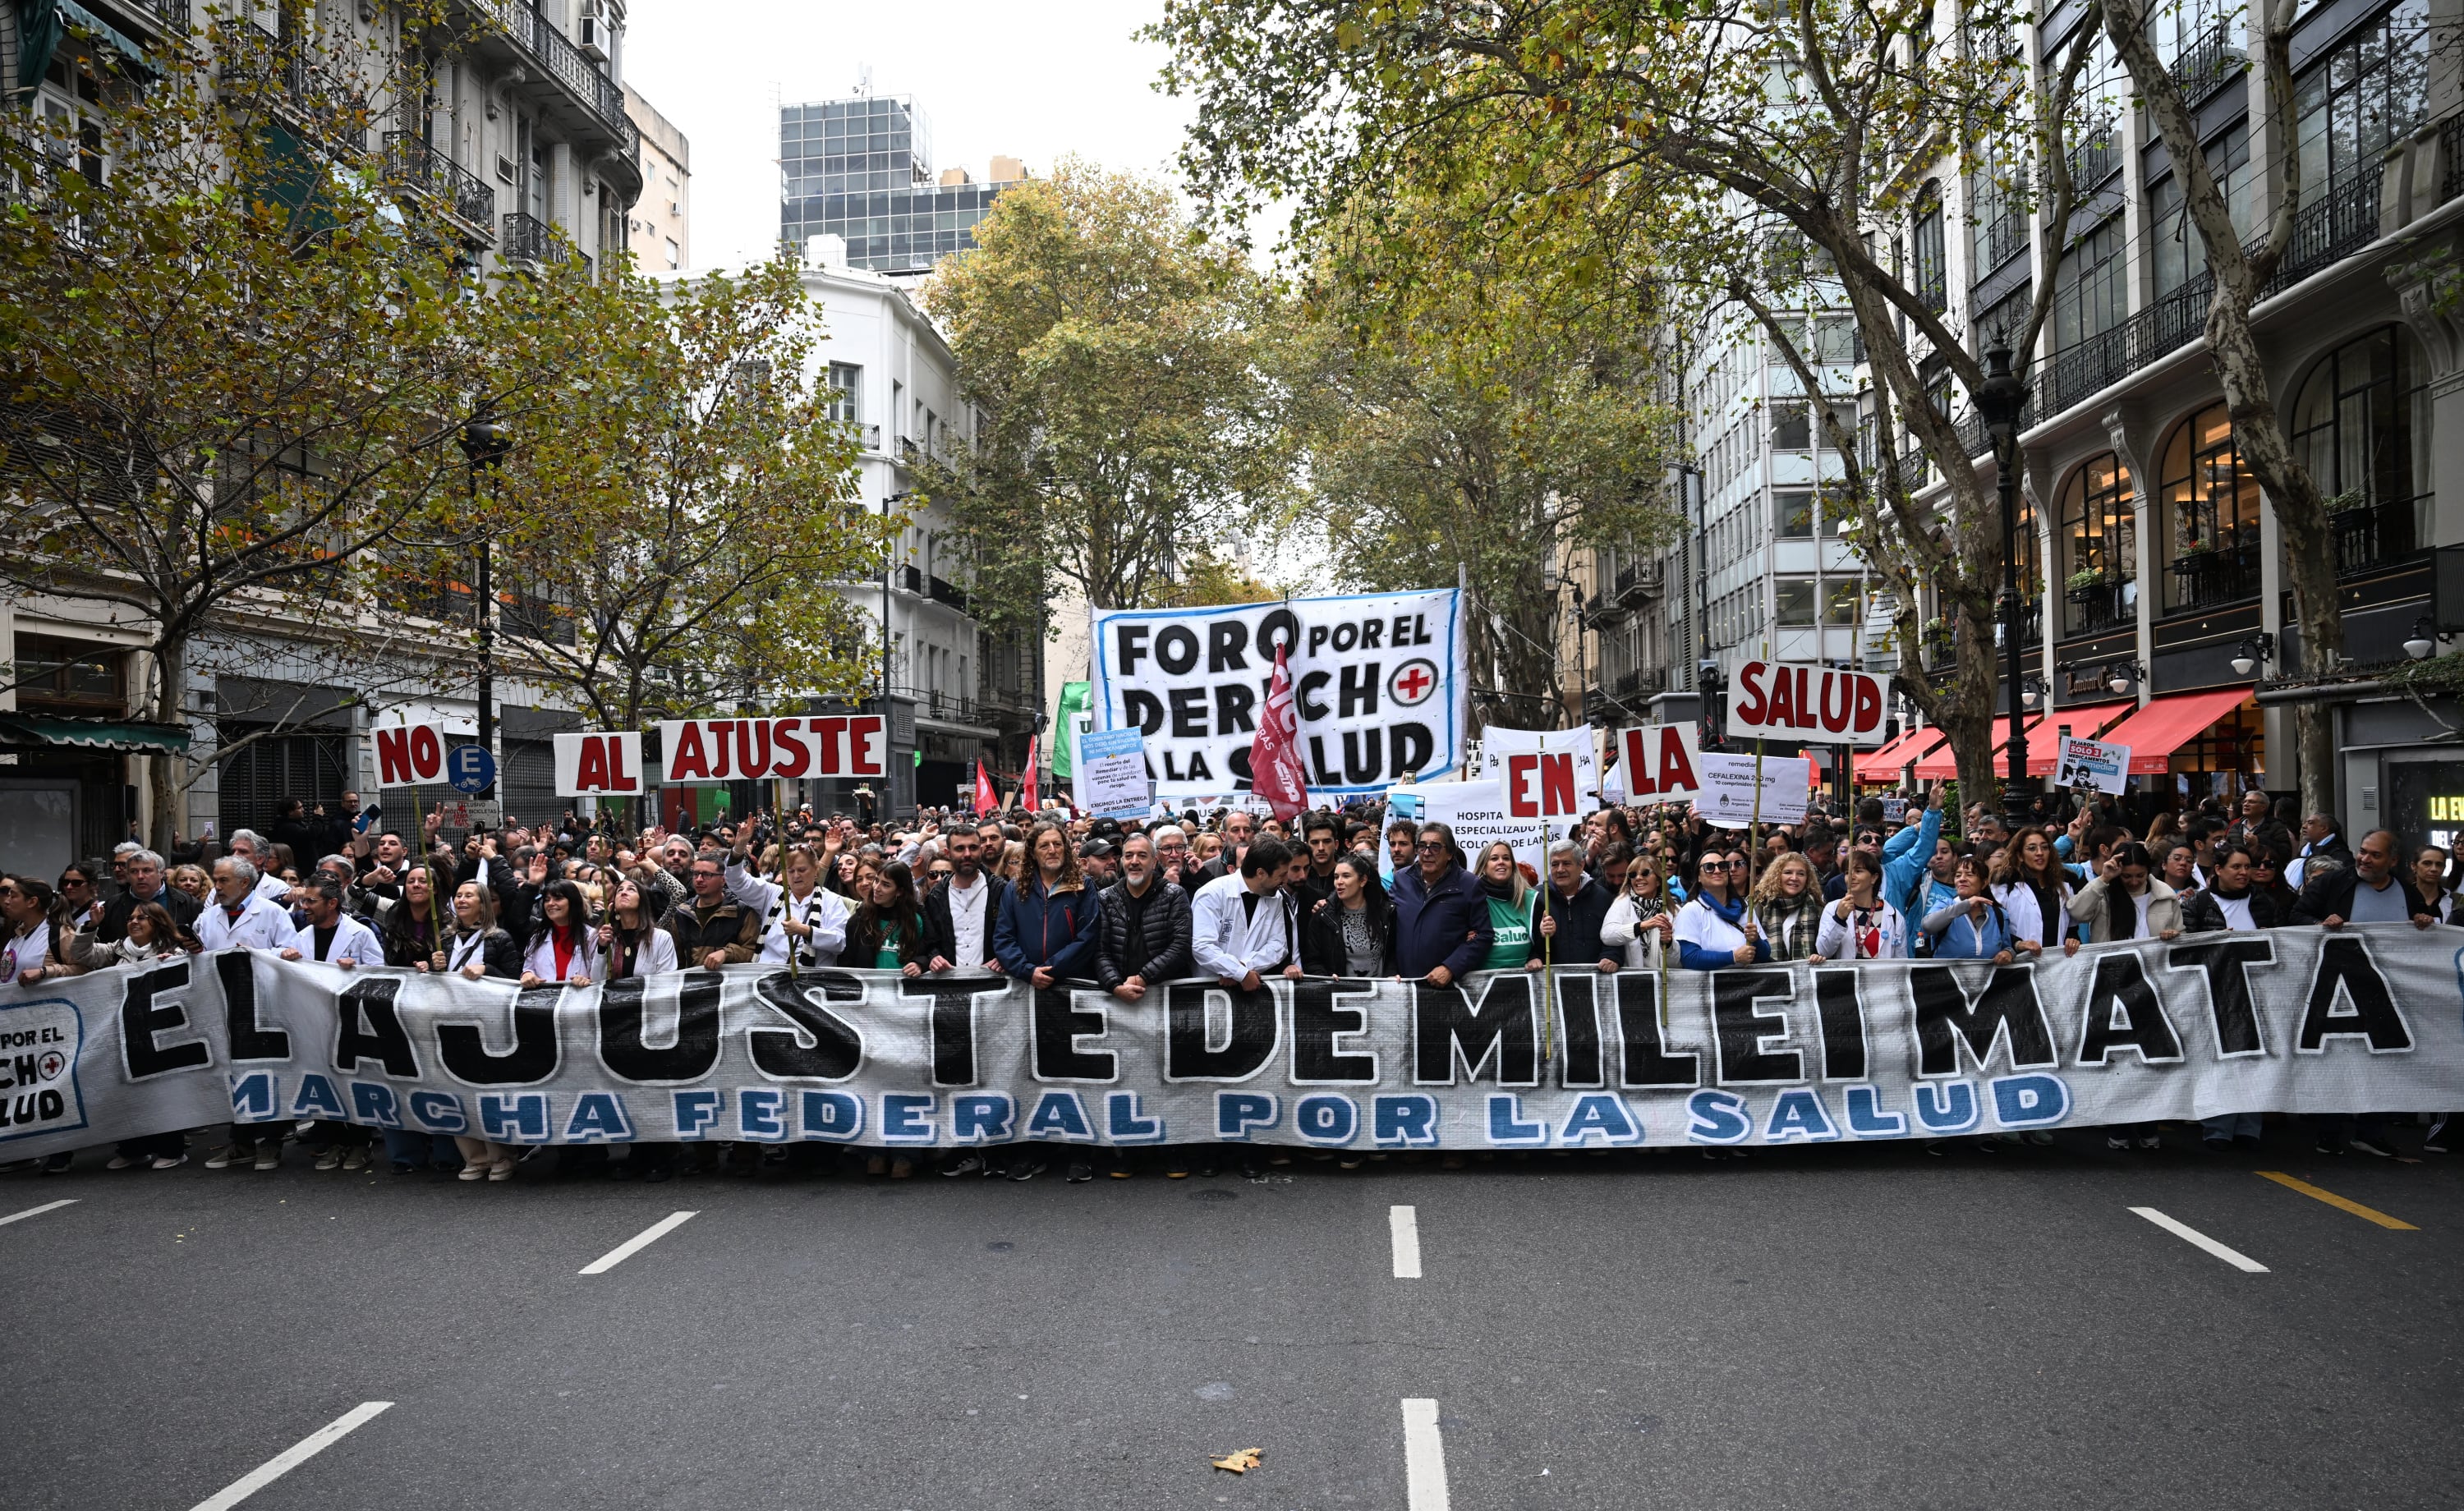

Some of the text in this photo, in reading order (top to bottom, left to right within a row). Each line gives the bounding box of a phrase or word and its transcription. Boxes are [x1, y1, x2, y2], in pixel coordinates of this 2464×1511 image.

[1118, 609, 1432, 676] FORO POR EL
[1736, 661, 1882, 733] SALUD
[376, 723, 441, 783] NO
[462, 748, 480, 772] E
[669, 717, 881, 780] AJUSTE
[1163, 751, 1213, 781] LA
[1229, 722, 1434, 791] SLUD
[2068, 753, 2110, 764] MEDICAMENTOS
[2071, 746, 2093, 755] SOLO
[577, 736, 637, 791] AL
[1096, 766, 1118, 774] Remediar
[1626, 726, 1699, 796] LA
[2080, 760, 2117, 772] remediar
[1509, 752, 1577, 818] EN
[1708, 772, 1749, 781] CEFALEXINA
[1091, 800, 1115, 808] EXIGIMOS
[1124, 796, 1147, 804] ENTREGA
[1111, 804, 1137, 812] INSUMOS.
[2431, 797, 2448, 820] LA
[1457, 811, 1504, 820] HOSPITA
[1455, 825, 1536, 834] ESPECIALIZADO
[1511, 838, 1524, 847] DE
[1528, 832, 1561, 846] LANÚS
[2432, 830, 2451, 849] DEL
[121, 934, 2416, 1088] EL AJUSTE DE MILEI MATA
[1, 1026, 64, 1049] POR EL
[231, 1069, 2075, 1147] MARCHA FEDERAL POR LA SALUD
